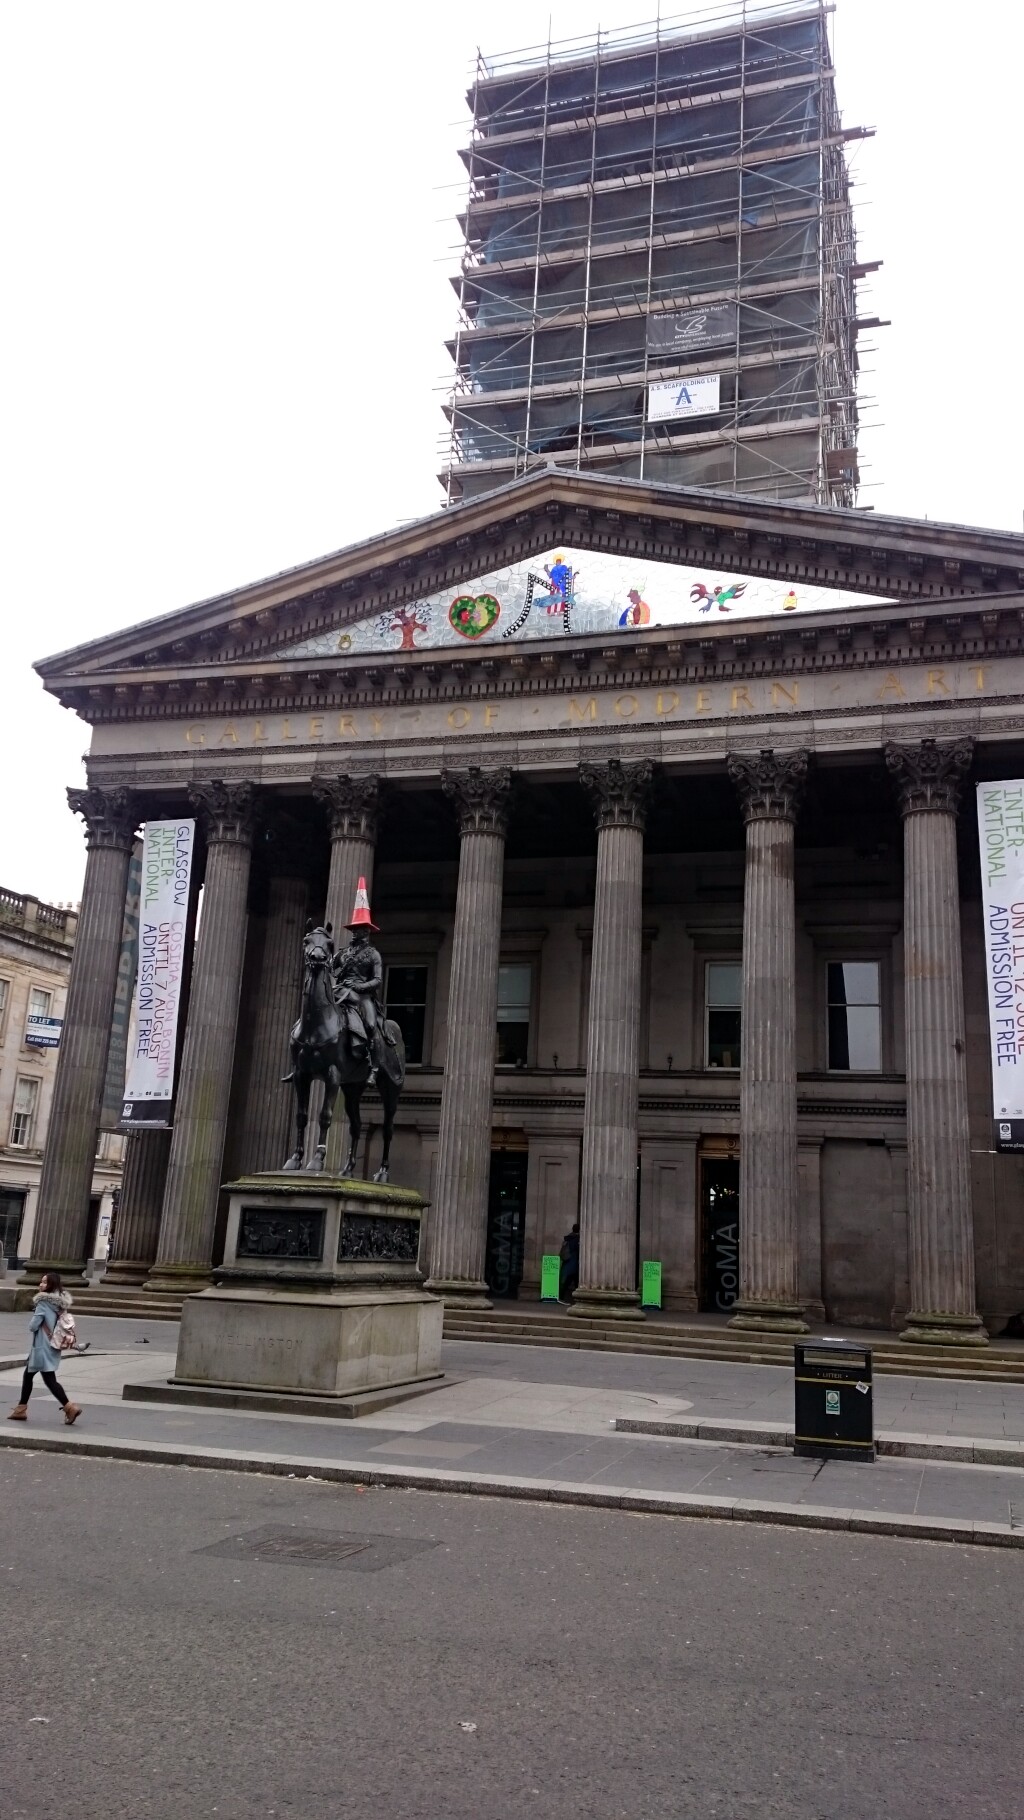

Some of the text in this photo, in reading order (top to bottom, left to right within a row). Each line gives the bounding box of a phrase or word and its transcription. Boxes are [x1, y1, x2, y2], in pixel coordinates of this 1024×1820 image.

[710, 304, 729, 312] Future
[664, 380, 706, 390] SCAFFOLDING
[186, 664, 993, 746] GALLERY OF MODERN ART
[1004, 788, 1024, 857] INTER-
[161, 826, 176, 885] INTER-
[174, 826, 190, 906] GLASGOW
[168, 920, 183, 985] COSIMA
[148, 922, 170, 1063] UNTIL 7 AUGUST
[166, 989, 180, 1022] VON
[136, 1018, 152, 1059] FREE
[996, 1018, 1017, 1067] FREE
[491, 1211, 512, 1294] GoMA
[716, 1223, 737, 1310] GoMA
[214, 1334, 304, 1350] WELLINGTON
